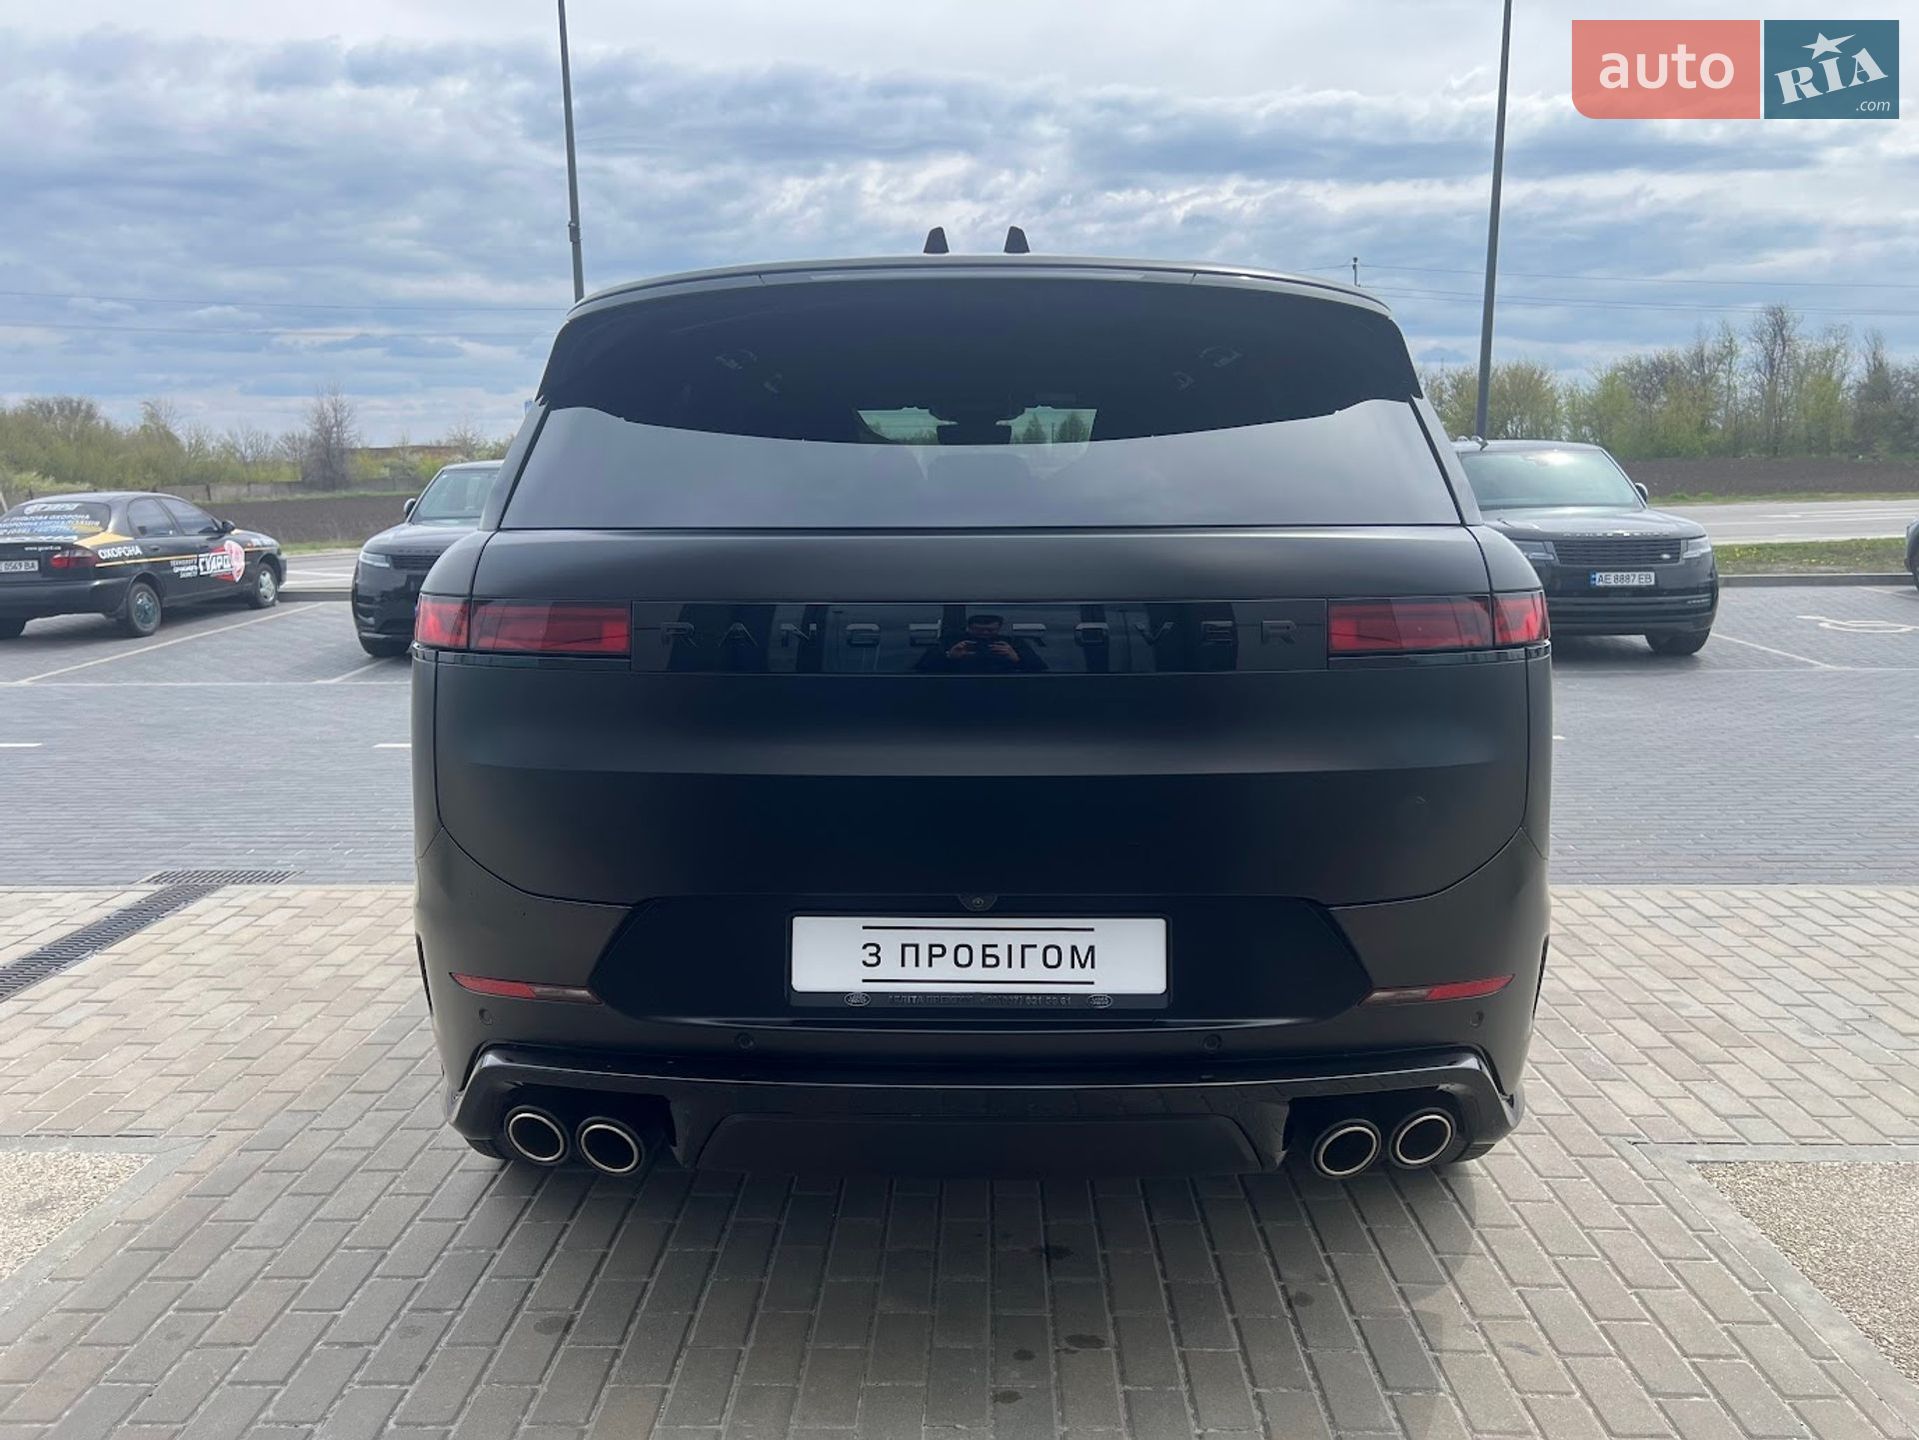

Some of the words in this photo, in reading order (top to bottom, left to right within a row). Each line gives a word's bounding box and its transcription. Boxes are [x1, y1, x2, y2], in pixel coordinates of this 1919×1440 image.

[98, 545, 142, 560] ОХОРОНА
[660, 619, 943, 647] RANGE
[1012, 619, 1299, 647] ROVER
[861, 942, 882, 968] З
[900, 942, 1096, 970] ПРОБІГОМ
